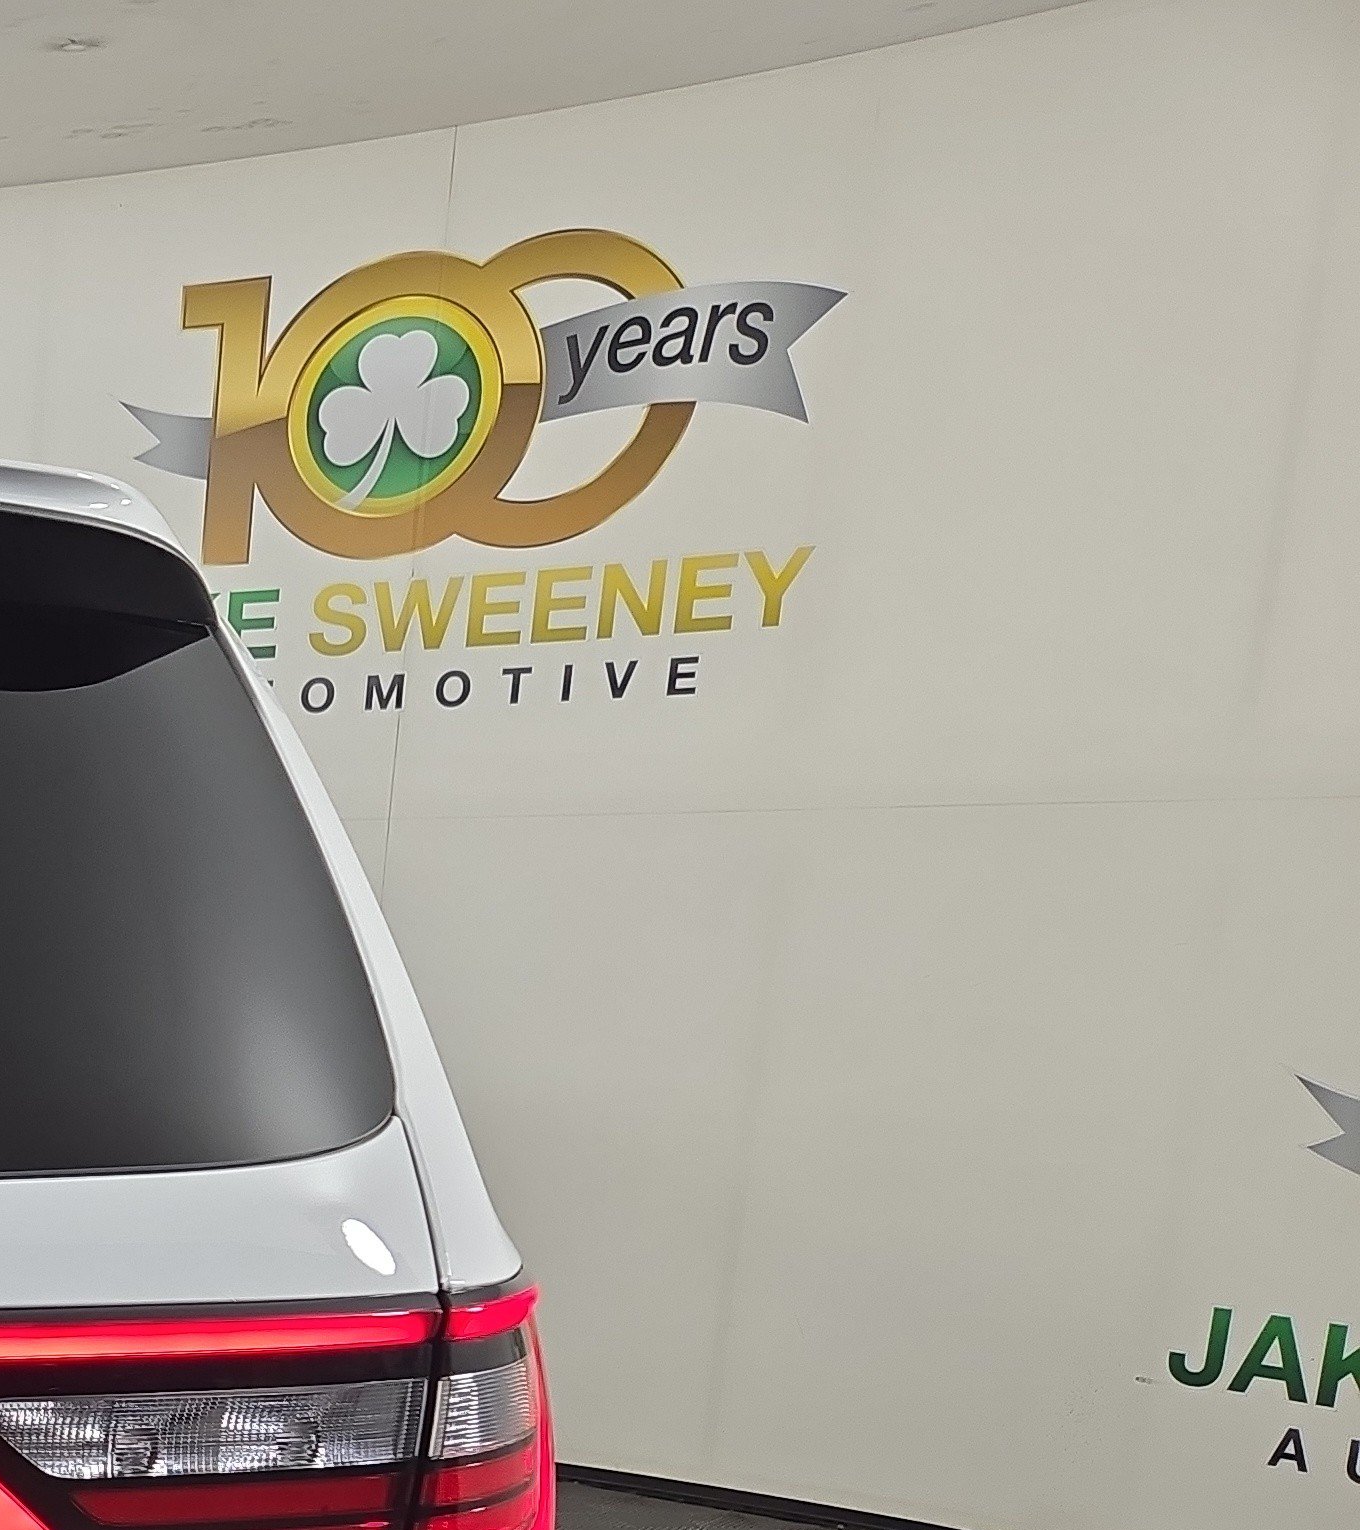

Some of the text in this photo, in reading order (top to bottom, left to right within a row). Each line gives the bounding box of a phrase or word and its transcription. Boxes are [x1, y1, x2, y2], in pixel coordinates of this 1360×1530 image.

[558, 300, 774, 406] years
[308, 545, 816, 658] SWEENEY
[267, 656, 700, 714] OMOTIVE
